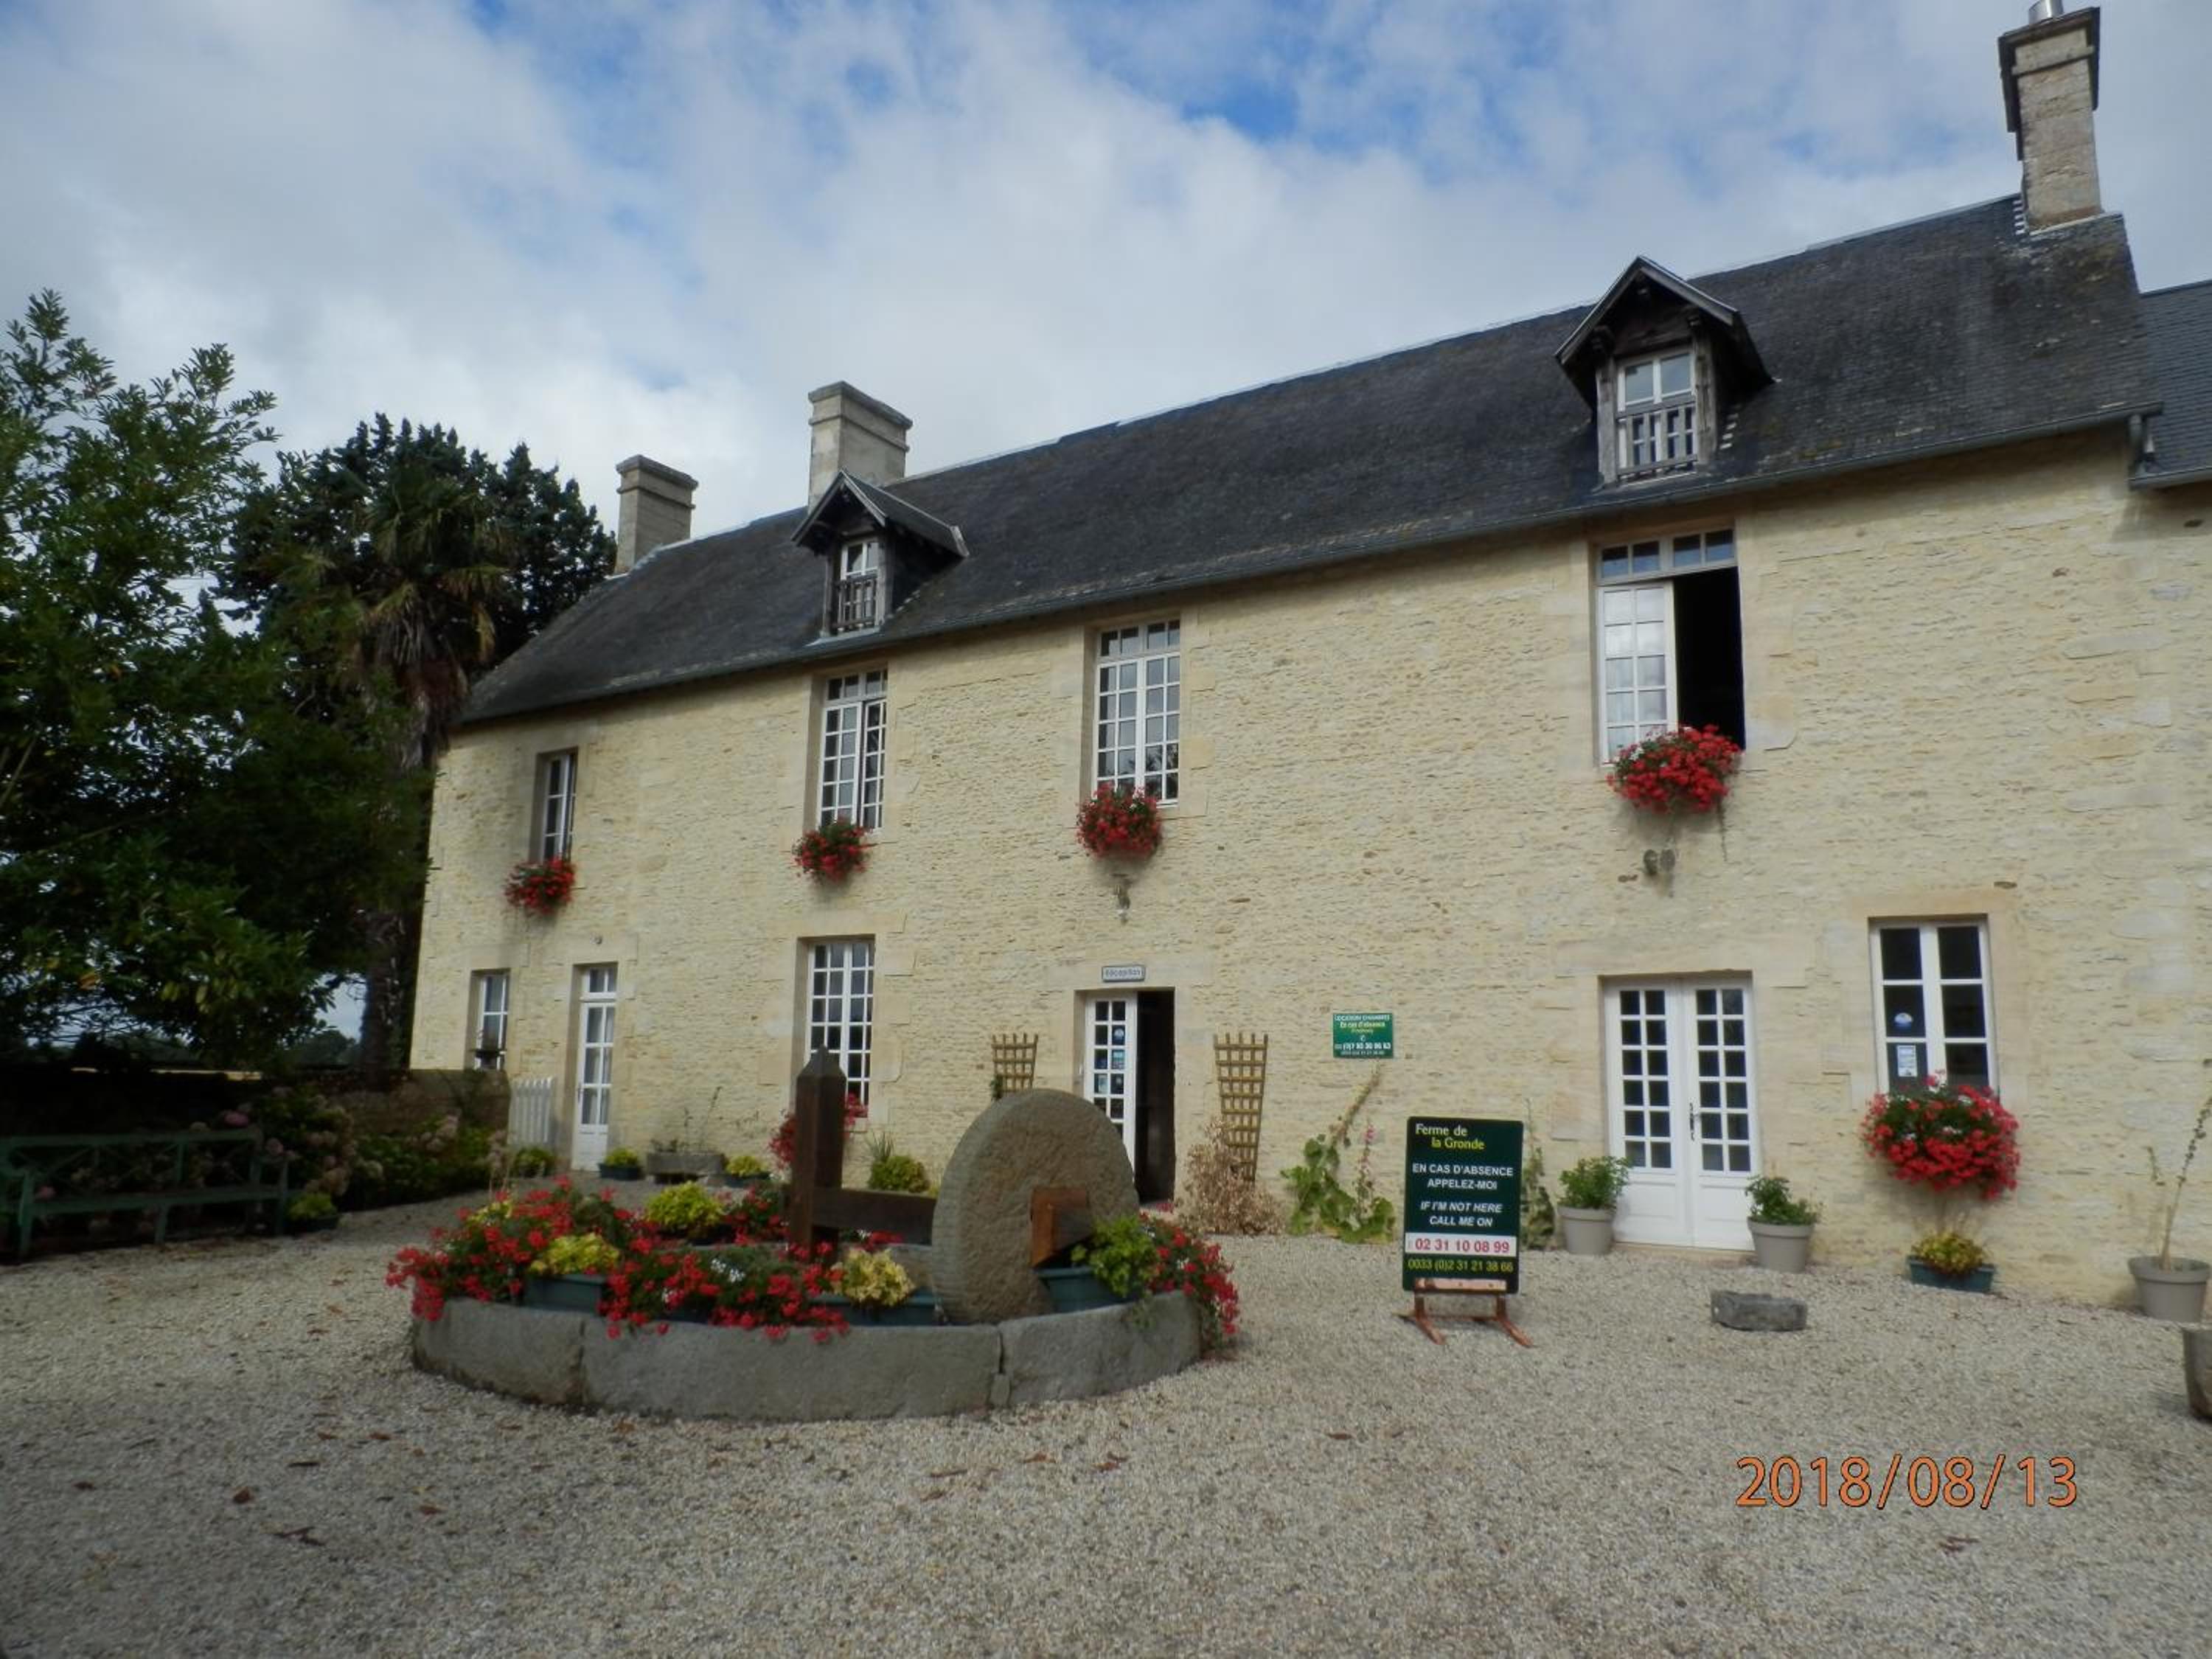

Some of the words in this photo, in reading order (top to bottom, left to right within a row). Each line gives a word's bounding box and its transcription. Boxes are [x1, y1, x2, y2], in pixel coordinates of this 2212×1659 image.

[1416, 1123, 1450, 1136] Ferme
[1454, 1124, 1467, 1136] de
[1431, 1137, 1441, 1148] la
[1444, 1137, 1485, 1150] Gronde
[1412, 1164, 1427, 1174] EN
[1429, 1164, 1450, 1175] CAS
[1453, 1165, 1513, 1176] D'ABSENCE
[1427, 1179, 1498, 1190] APPELEZ-MOI
[1420, 1201, 1431, 1211] IF
[1432, 1201, 1447, 1211] I'M
[1449, 1202, 1472, 1212] NOT
[1473, 1203, 1503, 1213] HERE
[1429, 1216, 1456, 1226] CALL
[1458, 1217, 1475, 1226] ME
[1477, 1217, 1493, 1228] ON
[1415, 1238, 1431, 1251] 02
[1435, 1239, 1449, 1251] 31
[1456, 1239, 1470, 1251] 10
[1474, 1240, 1489, 1252] 08
[1494, 1241, 1509, 1253] 99
[1435, 1259, 1454, 1271] (0)2
[1456, 1259, 1468, 1270] 31
[1471, 1260, 1483, 1271] 21
